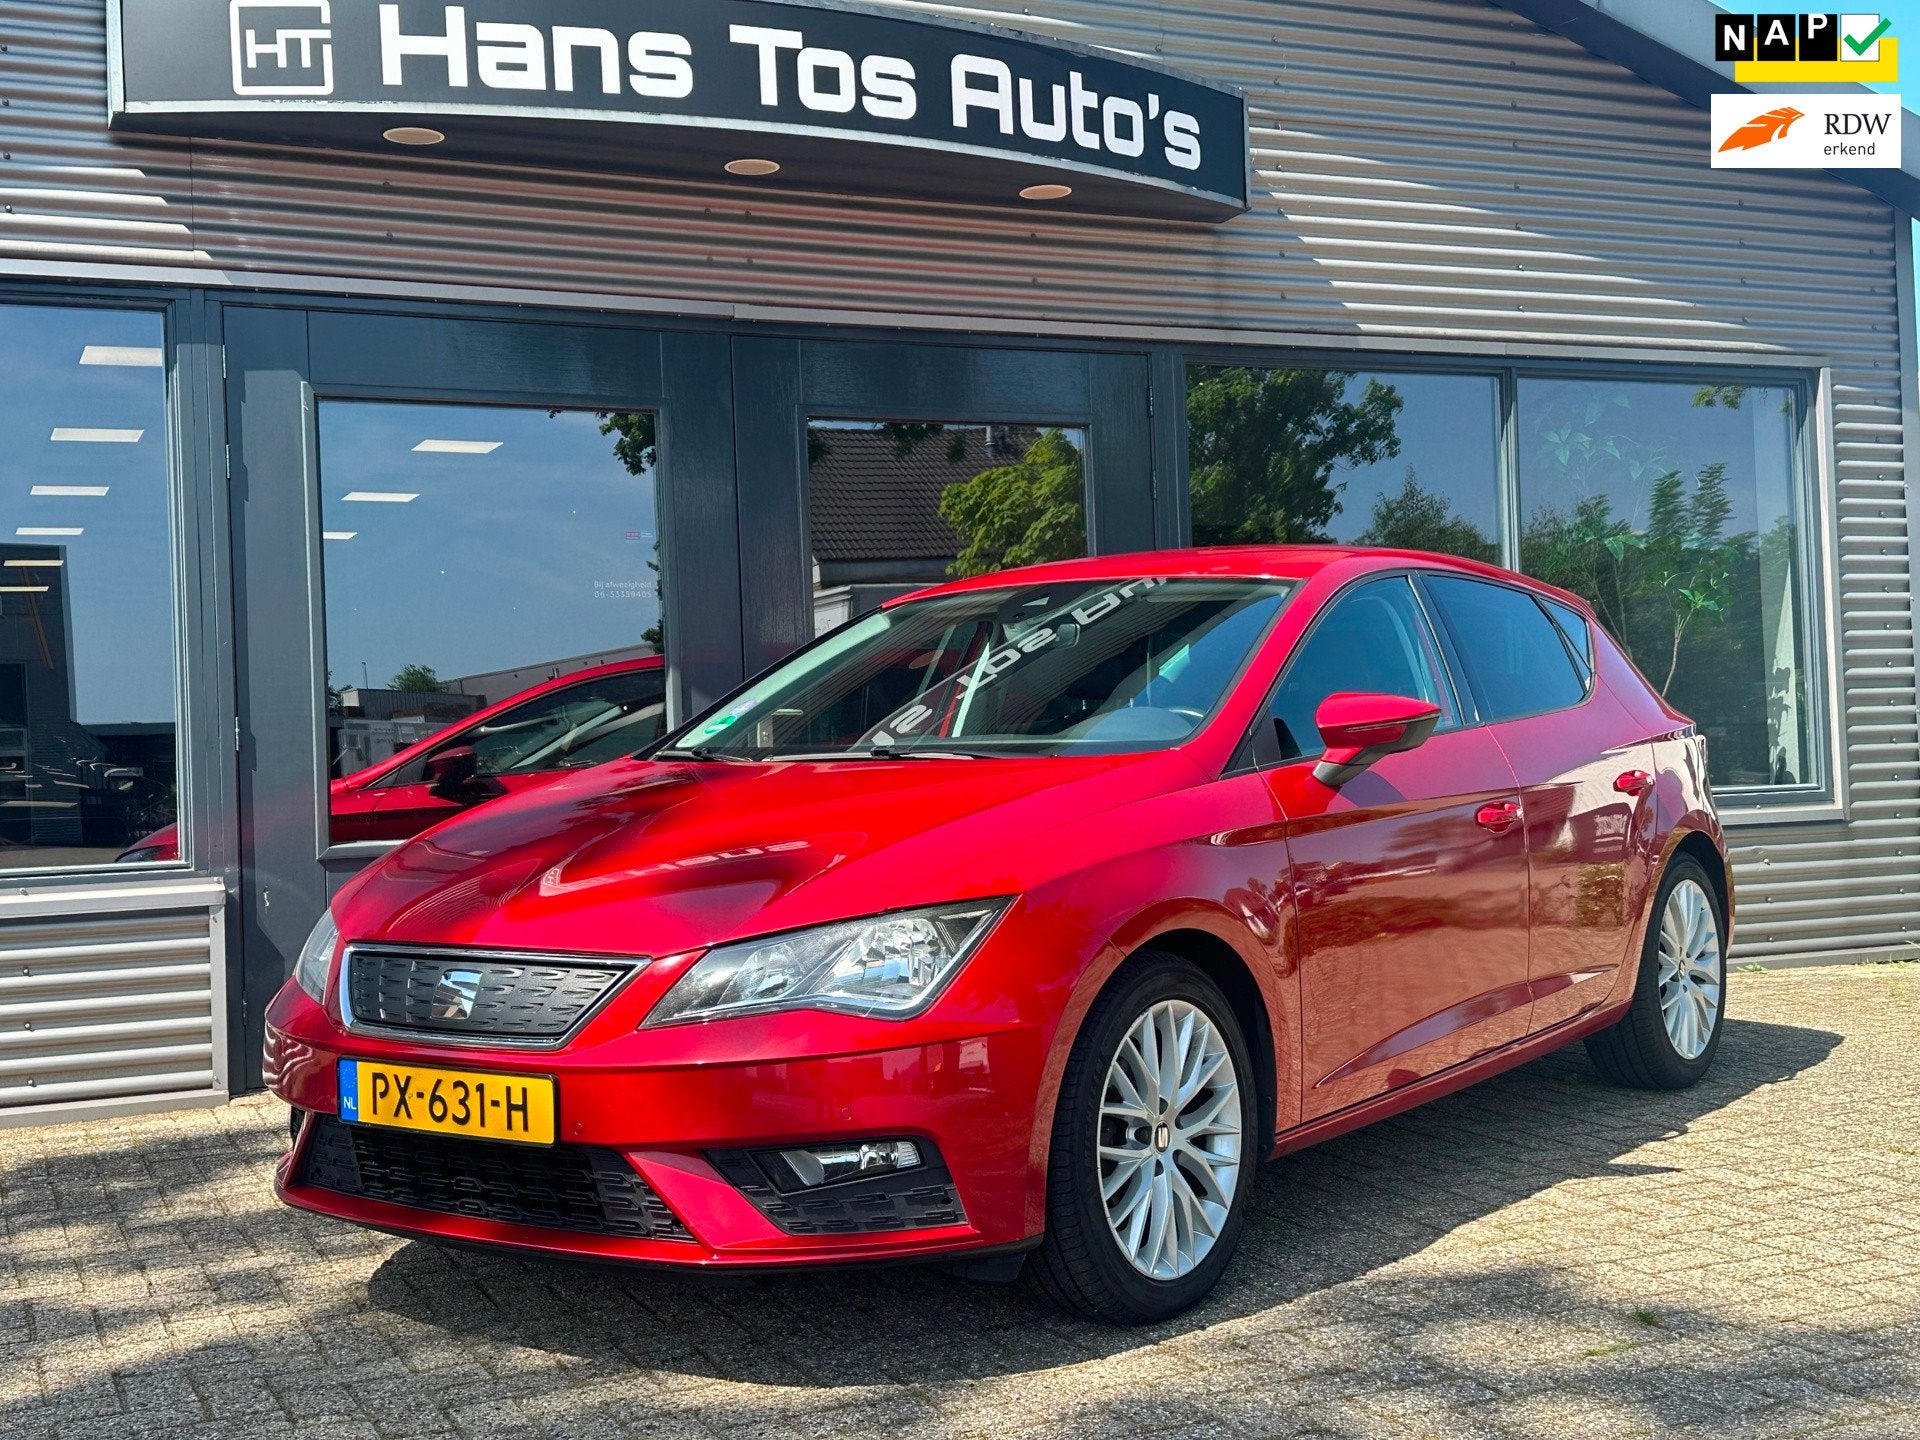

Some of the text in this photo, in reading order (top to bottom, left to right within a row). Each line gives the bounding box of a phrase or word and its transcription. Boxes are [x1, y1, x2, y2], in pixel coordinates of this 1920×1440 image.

[245, 28, 332, 68] HT
[379, 3, 1202, 171] Hans Tos Auto's
[343, 1096, 357, 1110] NL
[371, 1071, 529, 1132] PX-631-H
